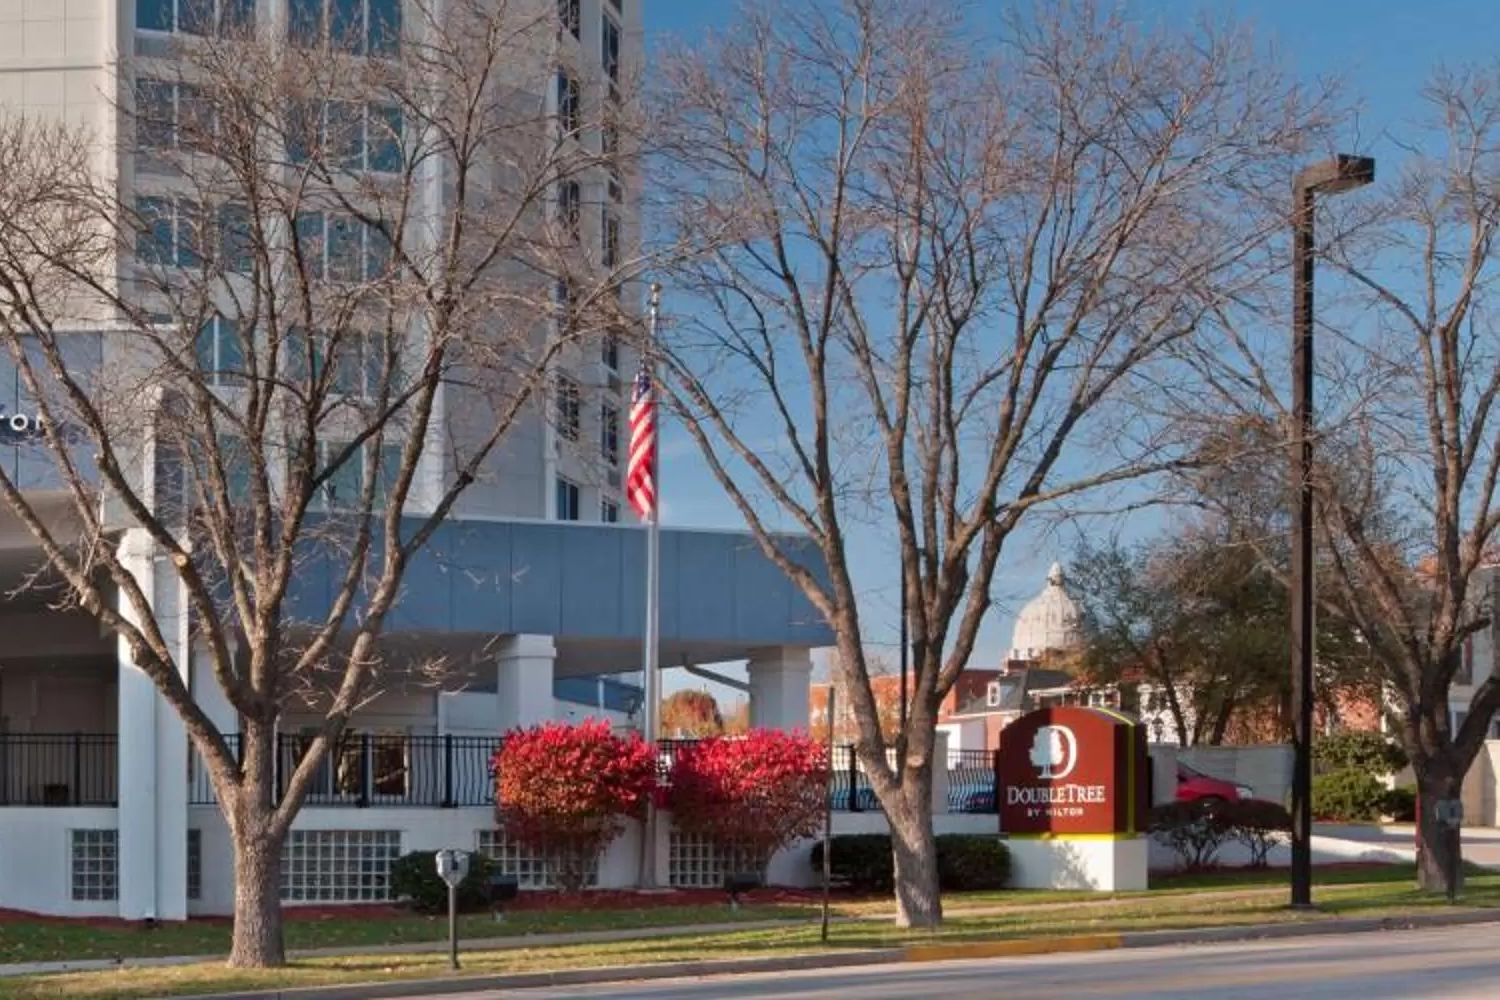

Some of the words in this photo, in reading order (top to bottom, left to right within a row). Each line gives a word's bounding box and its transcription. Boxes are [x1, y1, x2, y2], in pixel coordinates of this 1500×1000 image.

[1007, 783, 1106, 804] DOUBLETREE
[1027, 808, 1040, 817] BY
[1046, 807, 1084, 816] HILTON
